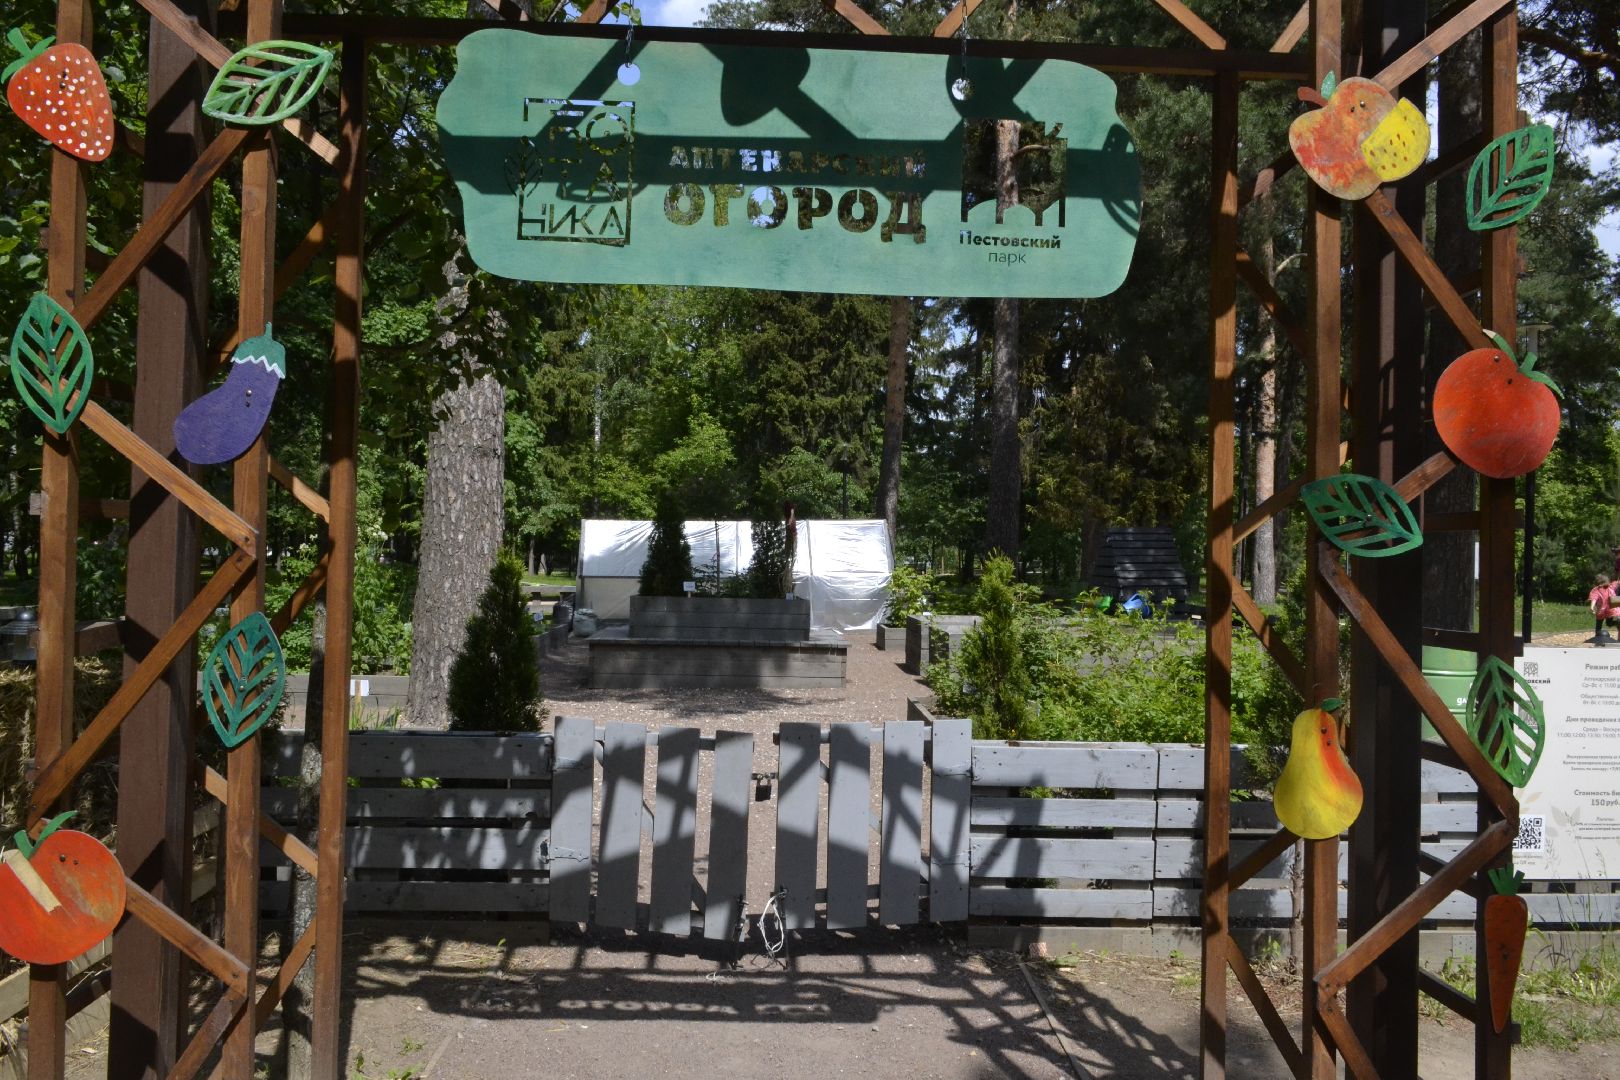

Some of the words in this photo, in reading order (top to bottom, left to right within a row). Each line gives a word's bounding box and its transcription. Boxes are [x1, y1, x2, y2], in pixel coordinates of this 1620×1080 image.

[669, 146, 927, 179] АПТЕКАРСКИЙ
[663, 182, 927, 244] ОГОРОД
[960, 229, 1062, 249] Пестовский
[988, 252, 1027, 267] парк
